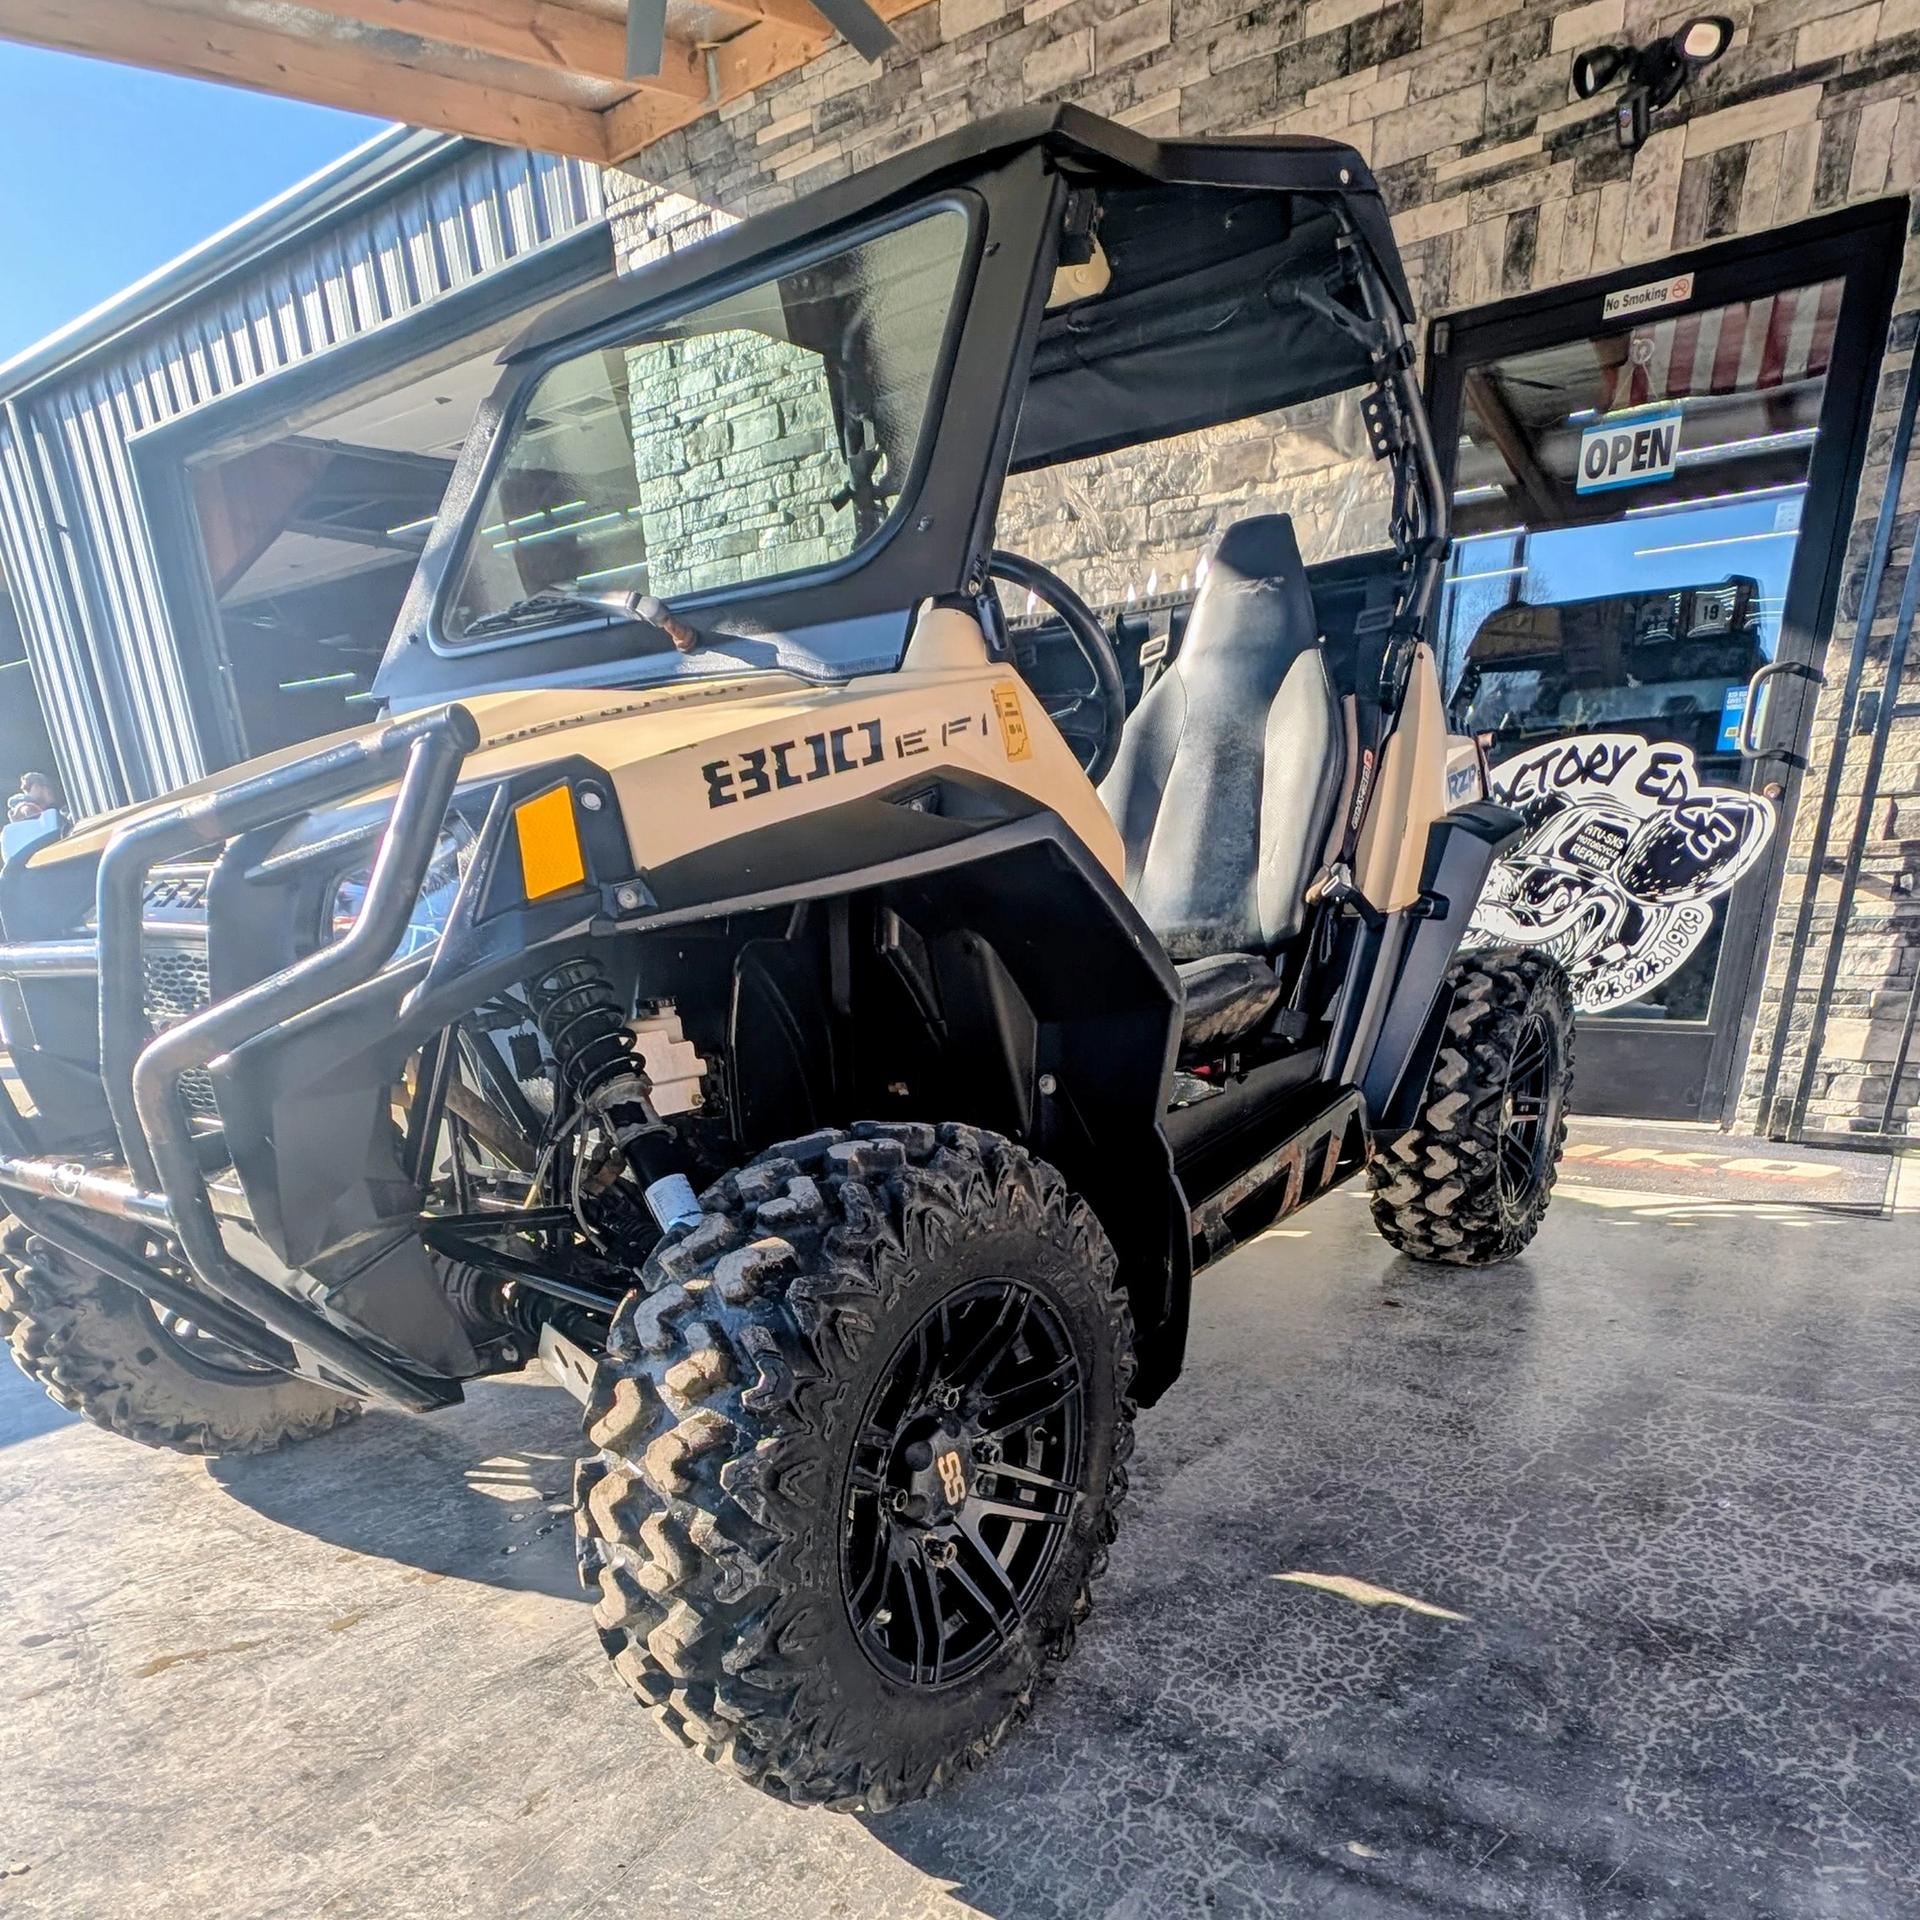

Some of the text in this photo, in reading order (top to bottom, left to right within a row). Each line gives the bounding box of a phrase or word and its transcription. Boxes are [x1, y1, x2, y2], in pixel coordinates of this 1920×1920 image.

[1605, 287, 1669, 313] No Smoking
[1584, 424, 1675, 479] OPEN
[700, 718, 885, 810] 800
[894, 702, 988, 758] EFI
[1492, 742, 1734, 859] ACTORY EDGE
[1576, 834, 1620, 859] MOTORCYCLE
[1584, 824, 1626, 850] ATV-SXS
[1569, 843, 1611, 870] REPAIR
